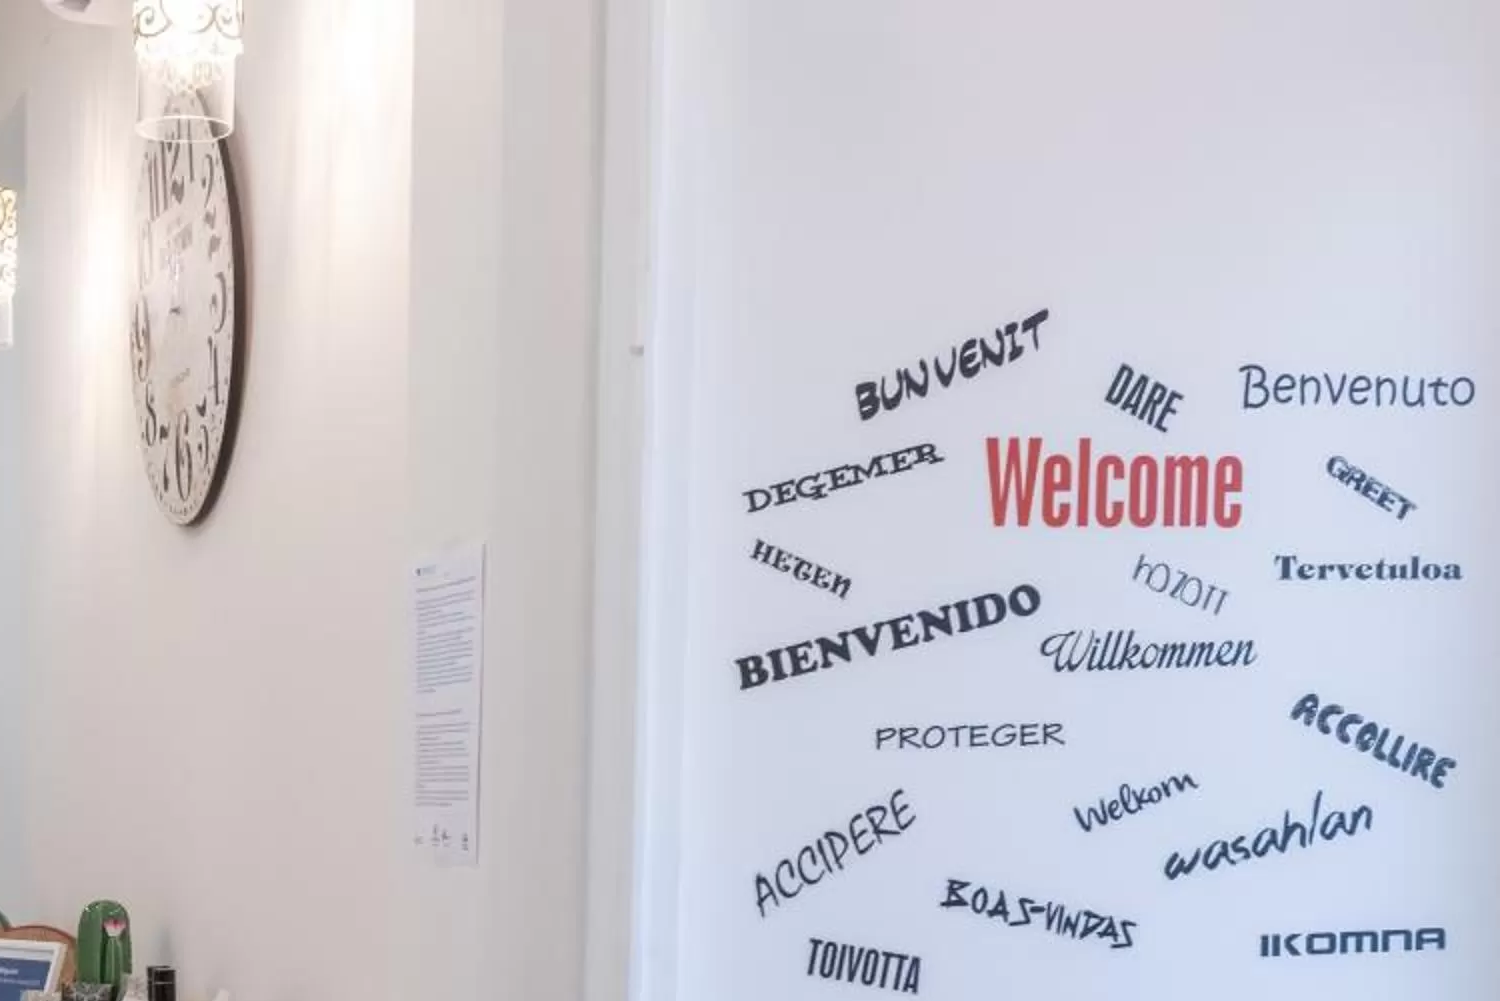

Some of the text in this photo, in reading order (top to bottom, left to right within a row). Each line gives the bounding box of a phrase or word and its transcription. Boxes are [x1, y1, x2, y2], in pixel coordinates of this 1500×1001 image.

[854, 308, 1049, 421] BUNVENIT
[1103, 362, 1184, 433] DARE
[1237, 363, 1476, 411] Benvenuto
[741, 442, 946, 513] DEGEMER
[984, 436, 1244, 529] Welcome
[1325, 455, 1417, 521] GREET
[1273, 554, 1464, 582] Tervetuloa
[733, 582, 1043, 692] BIENVENIDO
[1040, 628, 1257, 673] Willkommen
[874, 722, 1067, 751] PROTEGER
[1289, 692, 1457, 789] ACCOLLIRE
[1072, 773, 1199, 833] Welkom
[1164, 790, 1374, 881] wasahlan
[753, 788, 917, 918] ACCIPERE
[939, 878, 1139, 950] BOAS-VINDAS
[806, 937, 923, 996] TOIVOTTA
